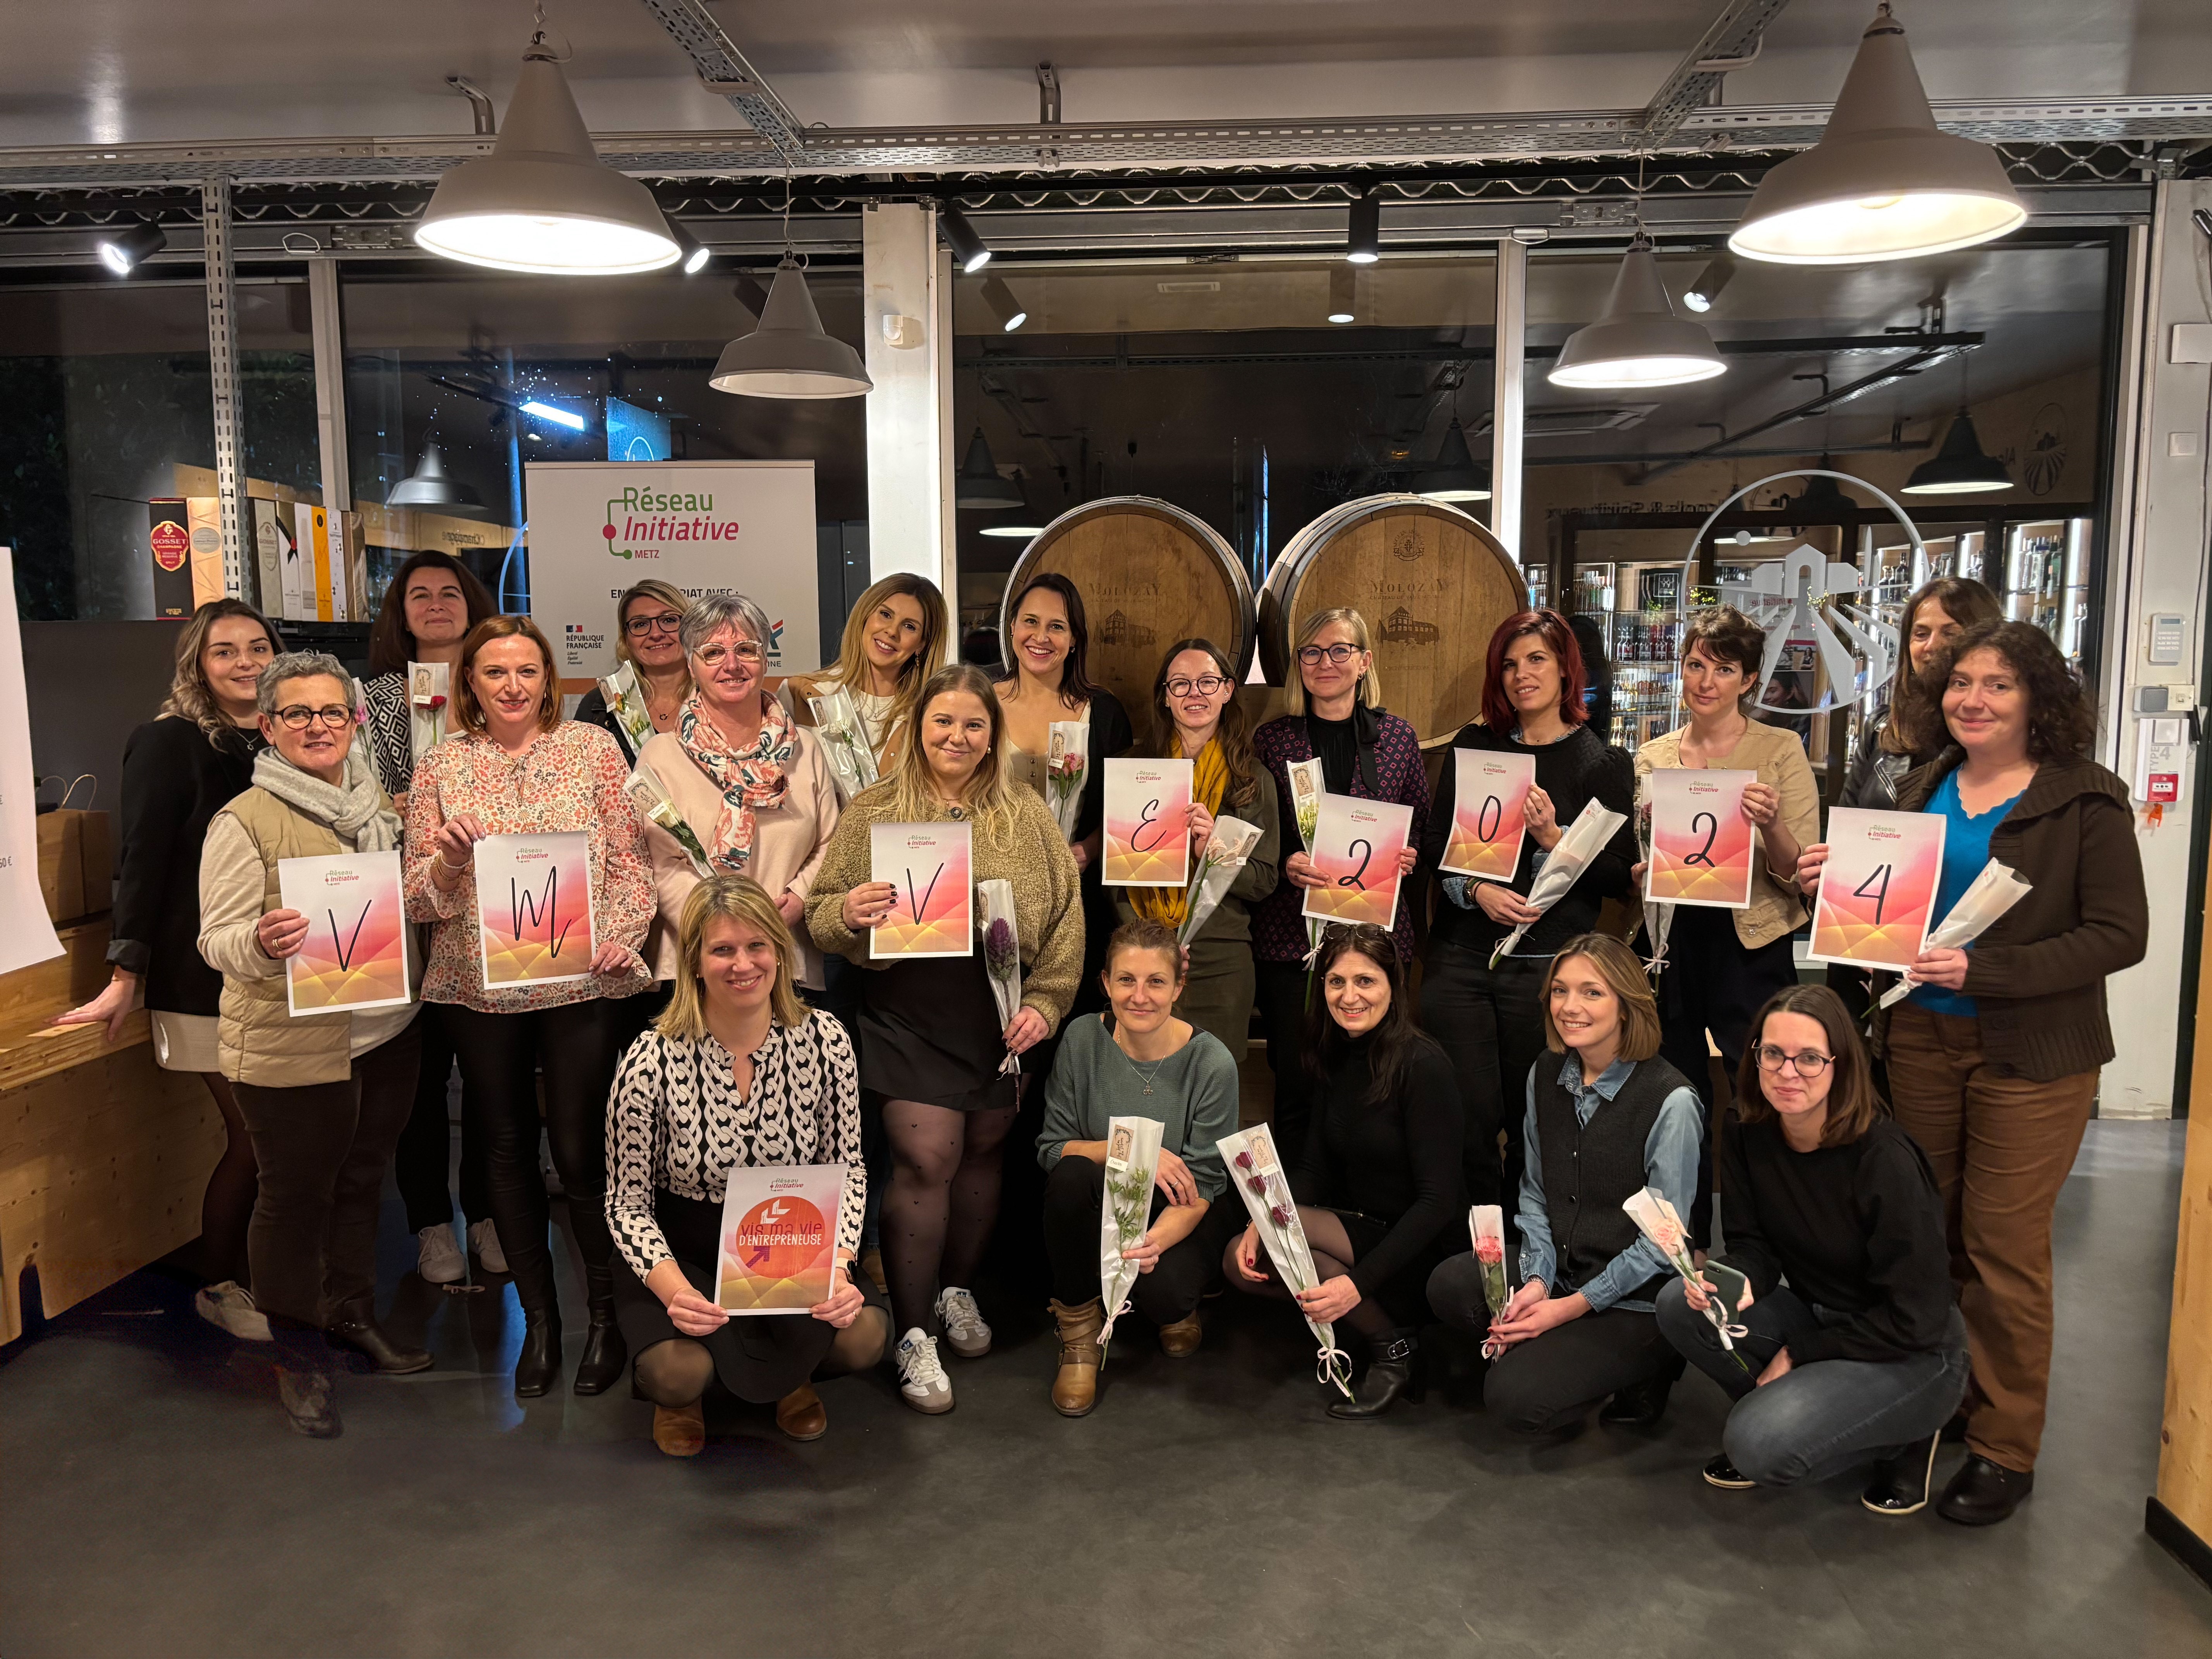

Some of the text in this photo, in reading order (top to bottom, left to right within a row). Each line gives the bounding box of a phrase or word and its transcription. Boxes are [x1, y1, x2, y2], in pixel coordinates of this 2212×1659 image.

[623, 486, 713, 512] Réseau
[624, 516, 738, 541] Initiative
[635, 550, 659, 558] METZ
[2150, 747, 2170, 773] TYPE 4
[1131, 799, 1167, 852] E
[1683, 812, 1717, 867] 2
[8, 856, 12, 866] €
[1338, 839, 1371, 891] 2
[511, 866, 572, 958] M
[907, 862, 944, 925] V
[1853, 864, 1891, 925] 4
[328, 908, 372, 972] V
[739, 1234, 822, 1246] D'ENTREPRENEUSE
[741, 1221, 822, 1237] vis ma vie
